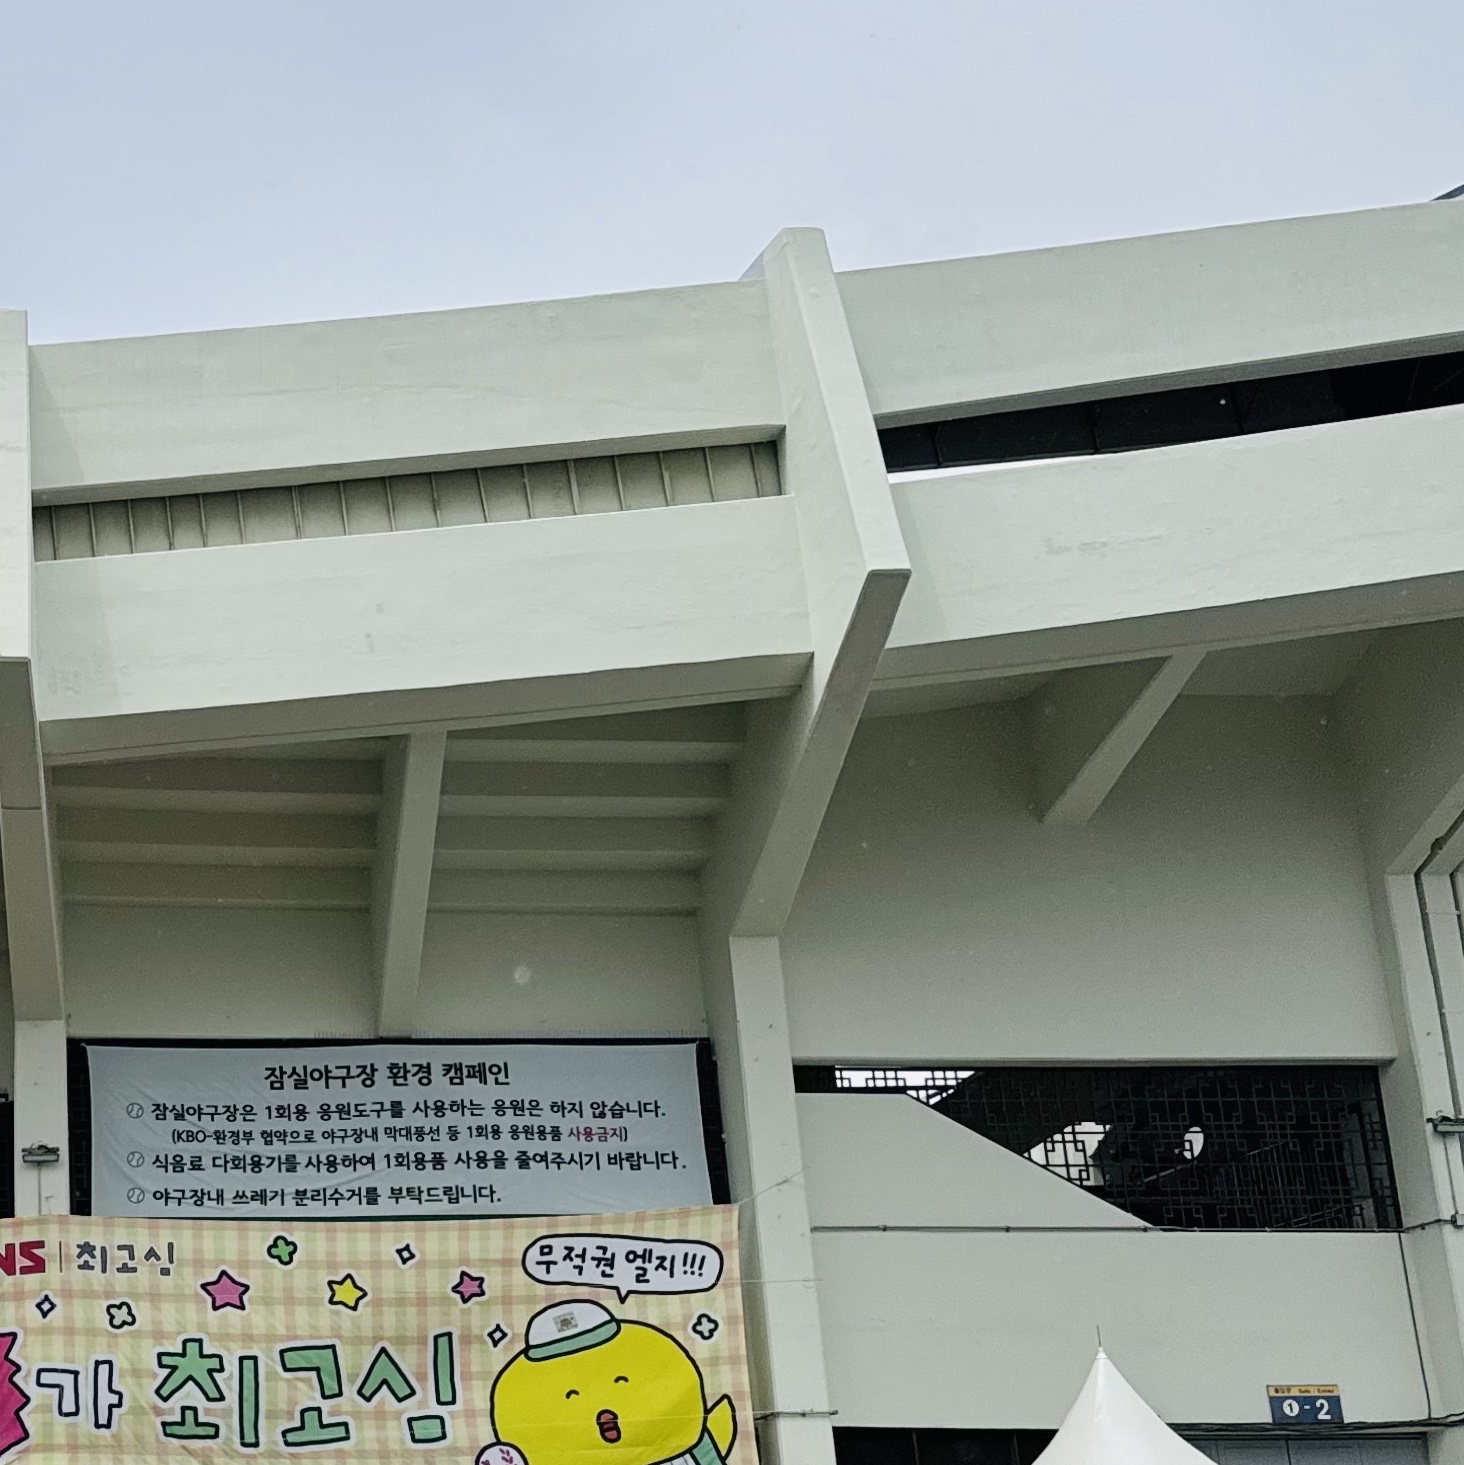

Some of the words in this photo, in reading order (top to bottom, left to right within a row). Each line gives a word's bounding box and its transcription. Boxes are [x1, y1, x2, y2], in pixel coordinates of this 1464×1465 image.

[264, 1063, 377, 1090] 잠실야구장
[386, 1062, 432, 1086] 환경
[441, 1061, 510, 1086] 캠페인
[151, 1103, 257, 1122] 잠실야구장은
[265, 1104, 309, 1121] 1회용
[316, 1101, 405, 1120] 응원도구를
[412, 1099, 485, 1117] 사용하는
[491, 1099, 543, 1118] 응원은
[549, 1100, 583, 1118] 하지
[589, 1100, 666, 1119] 않습니다.
[171, 1129, 254, 1145] (KBO-환경부
[260, 1129, 317, 1146] 협약으로
[321, 1127, 378, 1144] 야구장내
[384, 1125, 440, 1141] 막대풍선
[445, 1125, 460, 1141] 등
[466, 1124, 502, 1140] 1회용
[508, 1125, 562, 1141] 응원용품
[567, 1126, 627, 1141] 사용금지)
[151, 1153, 205, 1172] 식음료
[211, 1153, 300, 1173] 다회용기를
[304, 1152, 376, 1172] 사용하여
[383, 1151, 447, 1170] 1회용품
[454, 1150, 508, 1169] 사용을
[514, 1151, 600, 1170] 줄여주시기
[607, 1151, 686, 1170] 바랍니다.
[152, 1188, 224, 1206] 야구장내
[231, 1187, 285, 1206] 쓰레기
[291, 1186, 381, 1206] 분리수거를
[387, 1184, 501, 1204] 부탁드립니다.
[76, 1241, 175, 1277] 최고심
[535, 1244, 616, 1278] 무적권
[625, 1248, 706, 1283] 엘지!!!
[155, 1331, 458, 1448] 최고심
